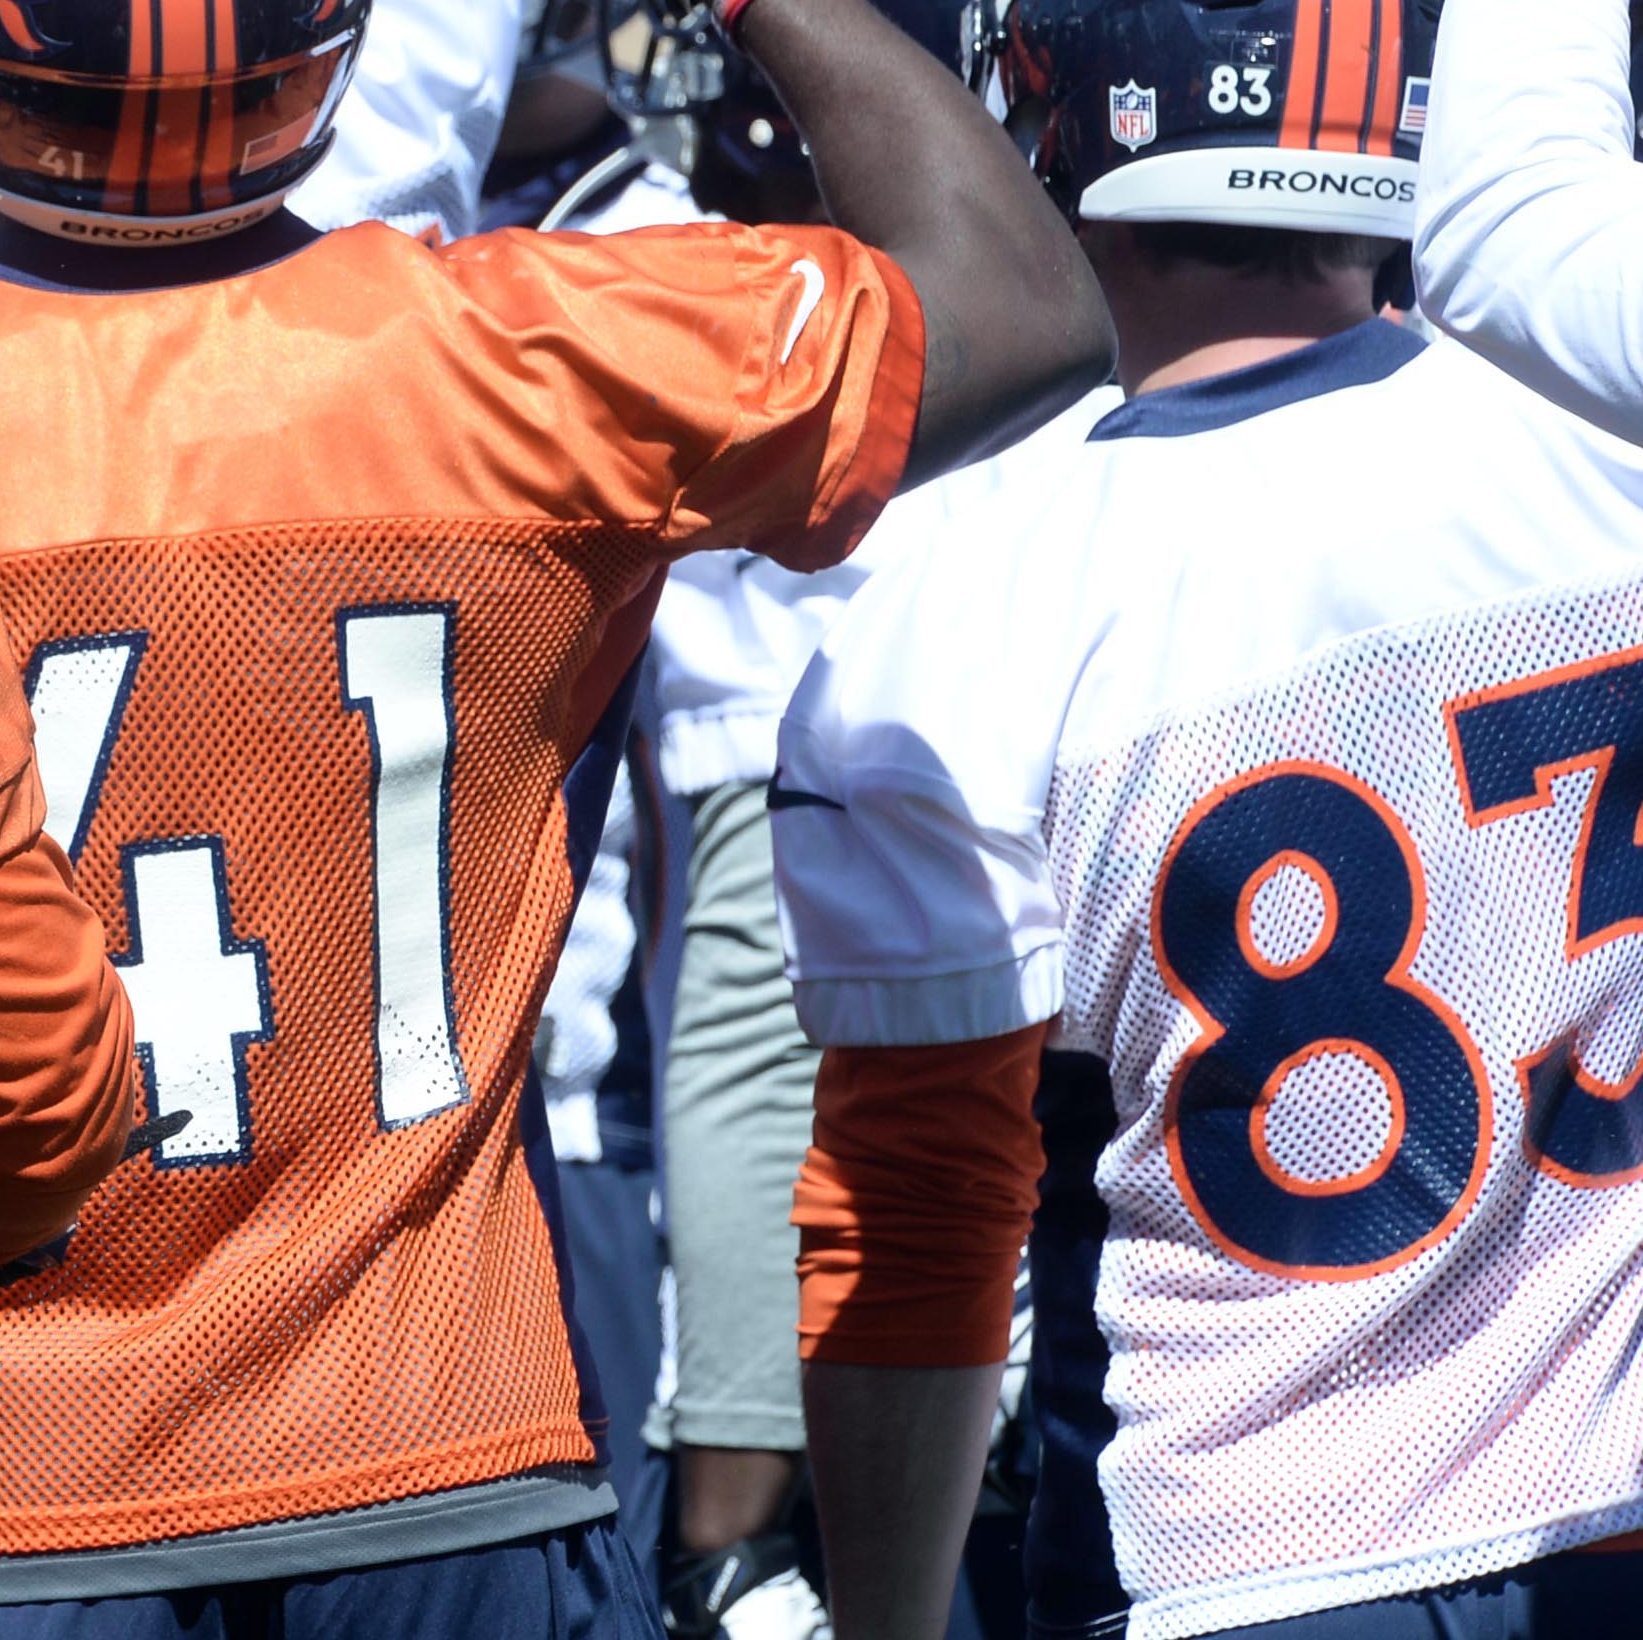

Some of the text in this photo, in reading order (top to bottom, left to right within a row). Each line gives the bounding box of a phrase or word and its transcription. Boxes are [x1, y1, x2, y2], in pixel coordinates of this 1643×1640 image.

[1208, 64, 1272, 116] 83
[1116, 112, 1150, 139] NFL
[38, 145, 84, 180] 41
[1227, 168, 1416, 202] BRONCOS
[60, 208, 266, 241] BRONCOS
[23, 600, 472, 1172] 41
